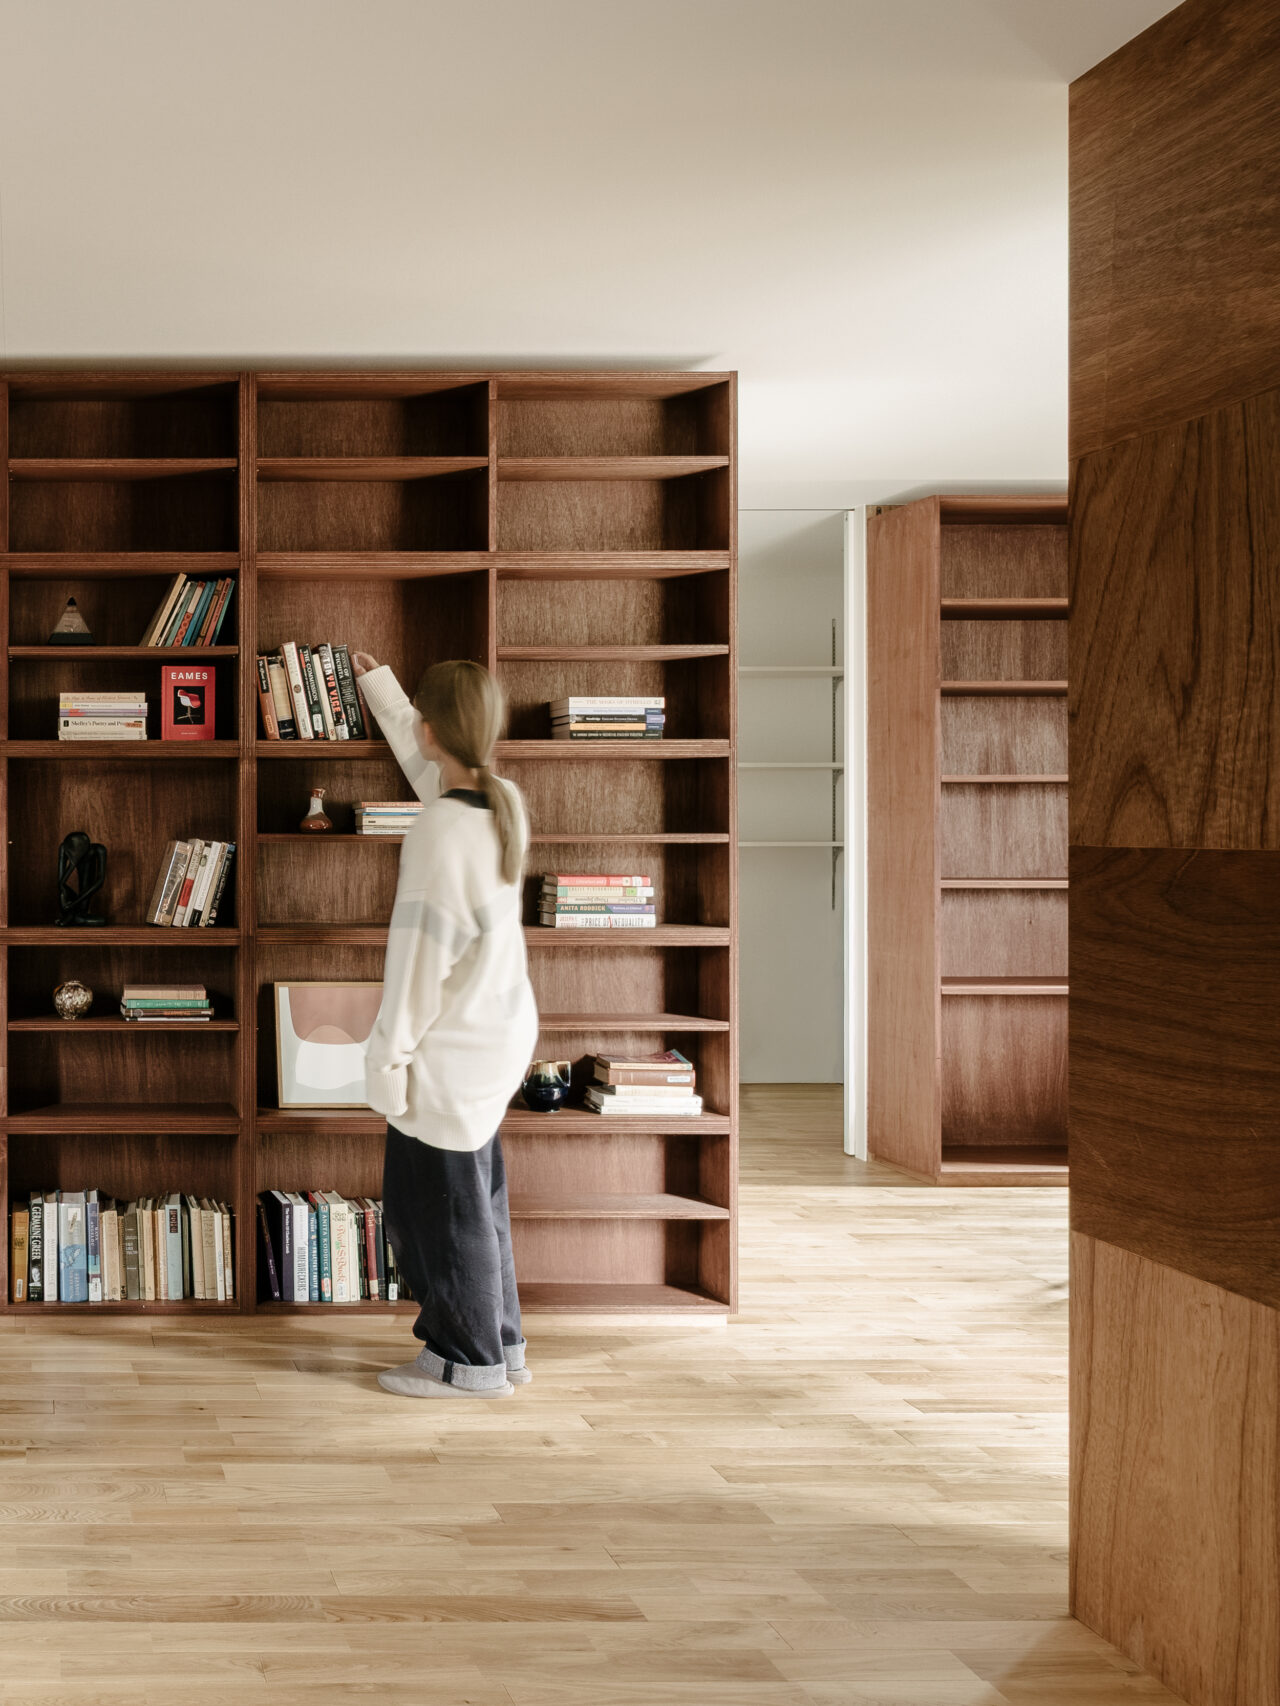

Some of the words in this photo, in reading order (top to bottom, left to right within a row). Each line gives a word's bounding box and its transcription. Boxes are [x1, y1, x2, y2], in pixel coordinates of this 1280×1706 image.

[171, 672, 208, 680] EAMES
[324, 658, 335, 687] TOKYO
[335, 653, 343, 679] WICHITA
[344, 668, 349, 677] OF
[305, 663, 318, 701] COMMISSION
[329, 690, 341, 712] VICE
[32, 1206, 41, 1239] GERMAINE
[32, 1239, 41, 1260] GREER
